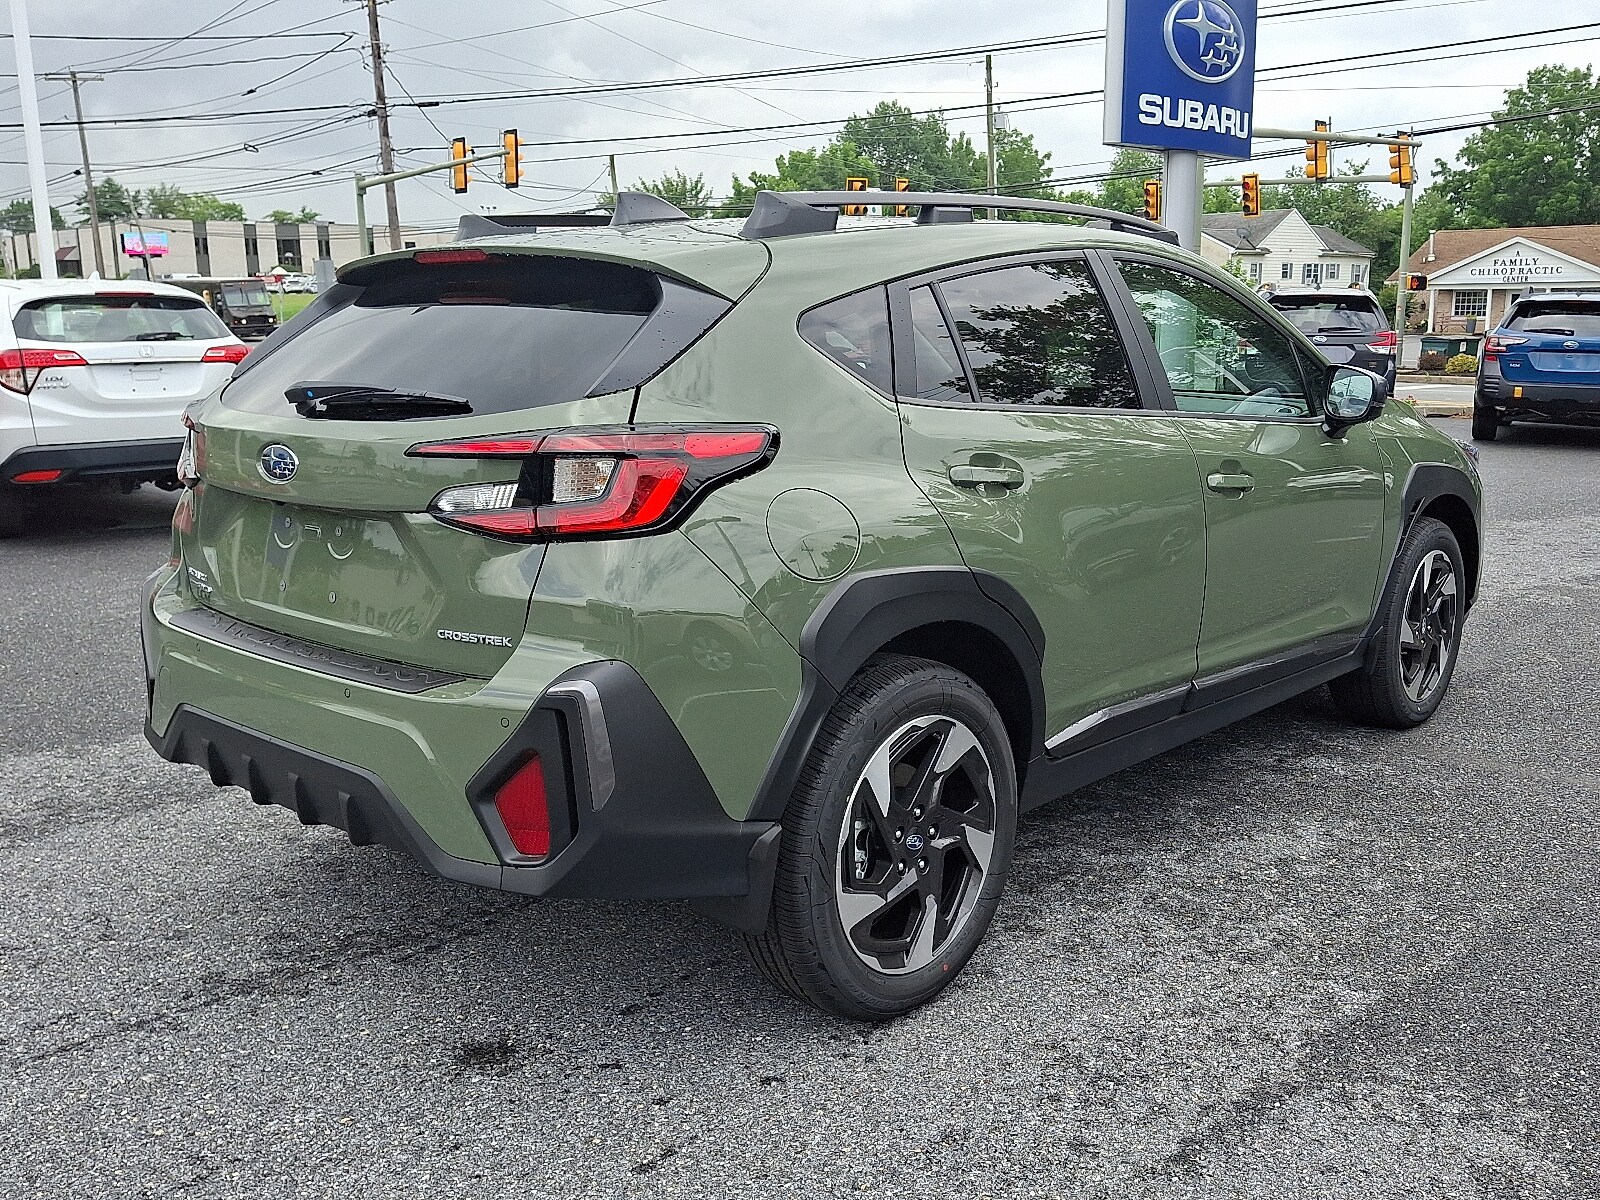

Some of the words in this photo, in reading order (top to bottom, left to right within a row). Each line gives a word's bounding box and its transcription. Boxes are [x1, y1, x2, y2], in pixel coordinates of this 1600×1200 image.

[1138, 93, 1249, 139] SUBARU
[1493, 258, 1539, 267] FAMILY
[1470, 266, 1563, 276] CHIROPRACTIC
[437, 629, 513, 648] CROSSTREK
